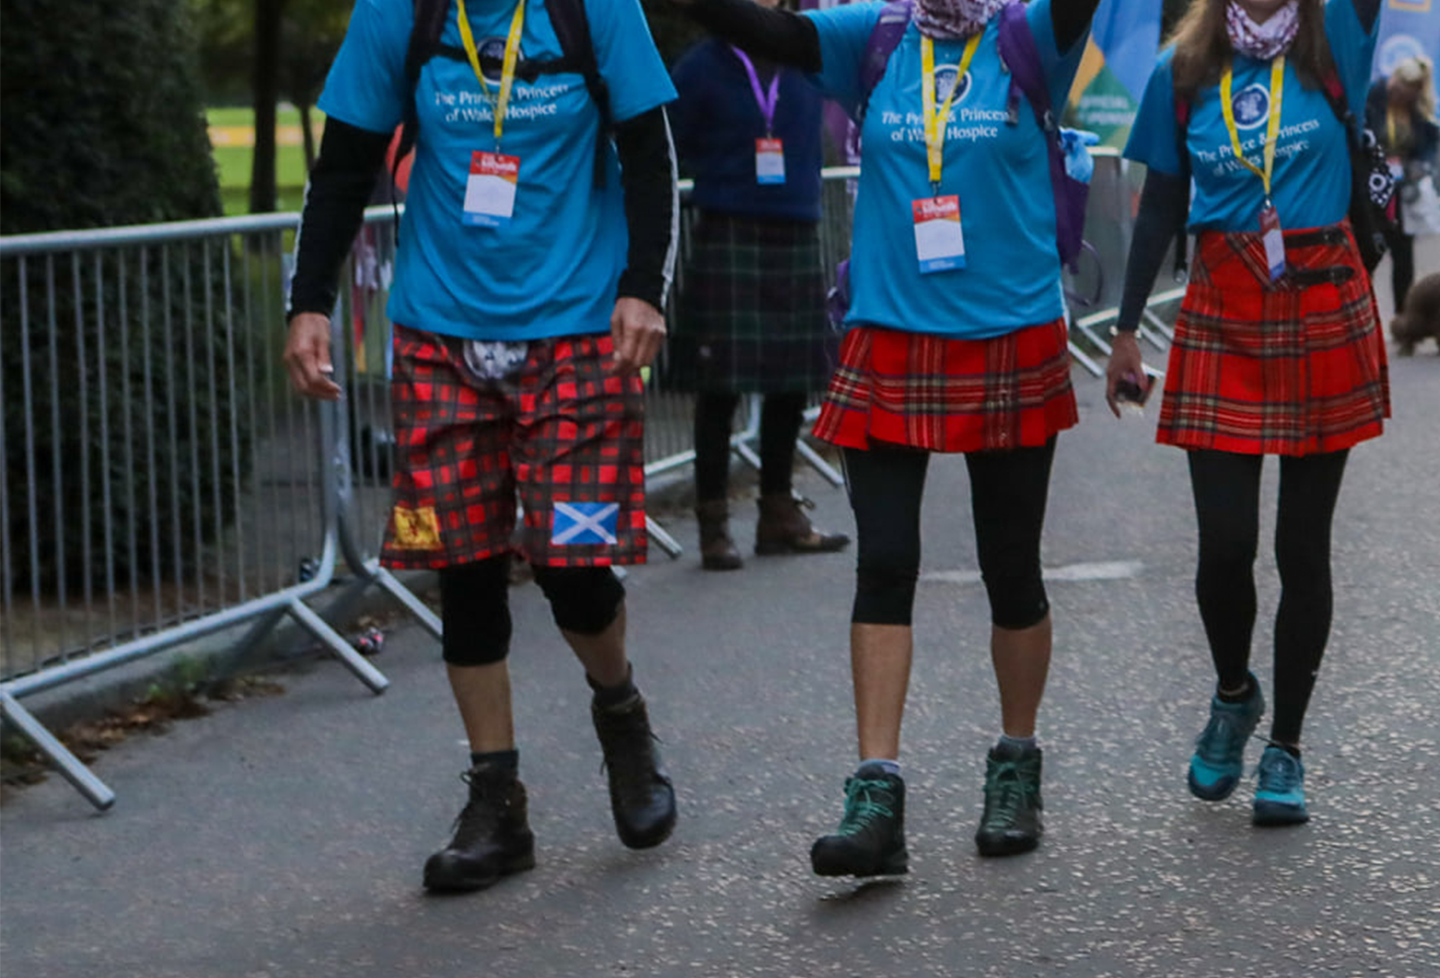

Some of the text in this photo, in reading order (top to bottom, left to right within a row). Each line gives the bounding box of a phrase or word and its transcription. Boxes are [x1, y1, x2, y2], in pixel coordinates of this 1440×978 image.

[445, 107, 460, 123] of
[504, 103, 557, 121] Hospice
[882, 111, 903, 125] The
[891, 127, 905, 142] of
[947, 124, 998, 142] Hospice
[1219, 138, 1257, 158] Prce
[1278, 118, 1320, 139] rincess
